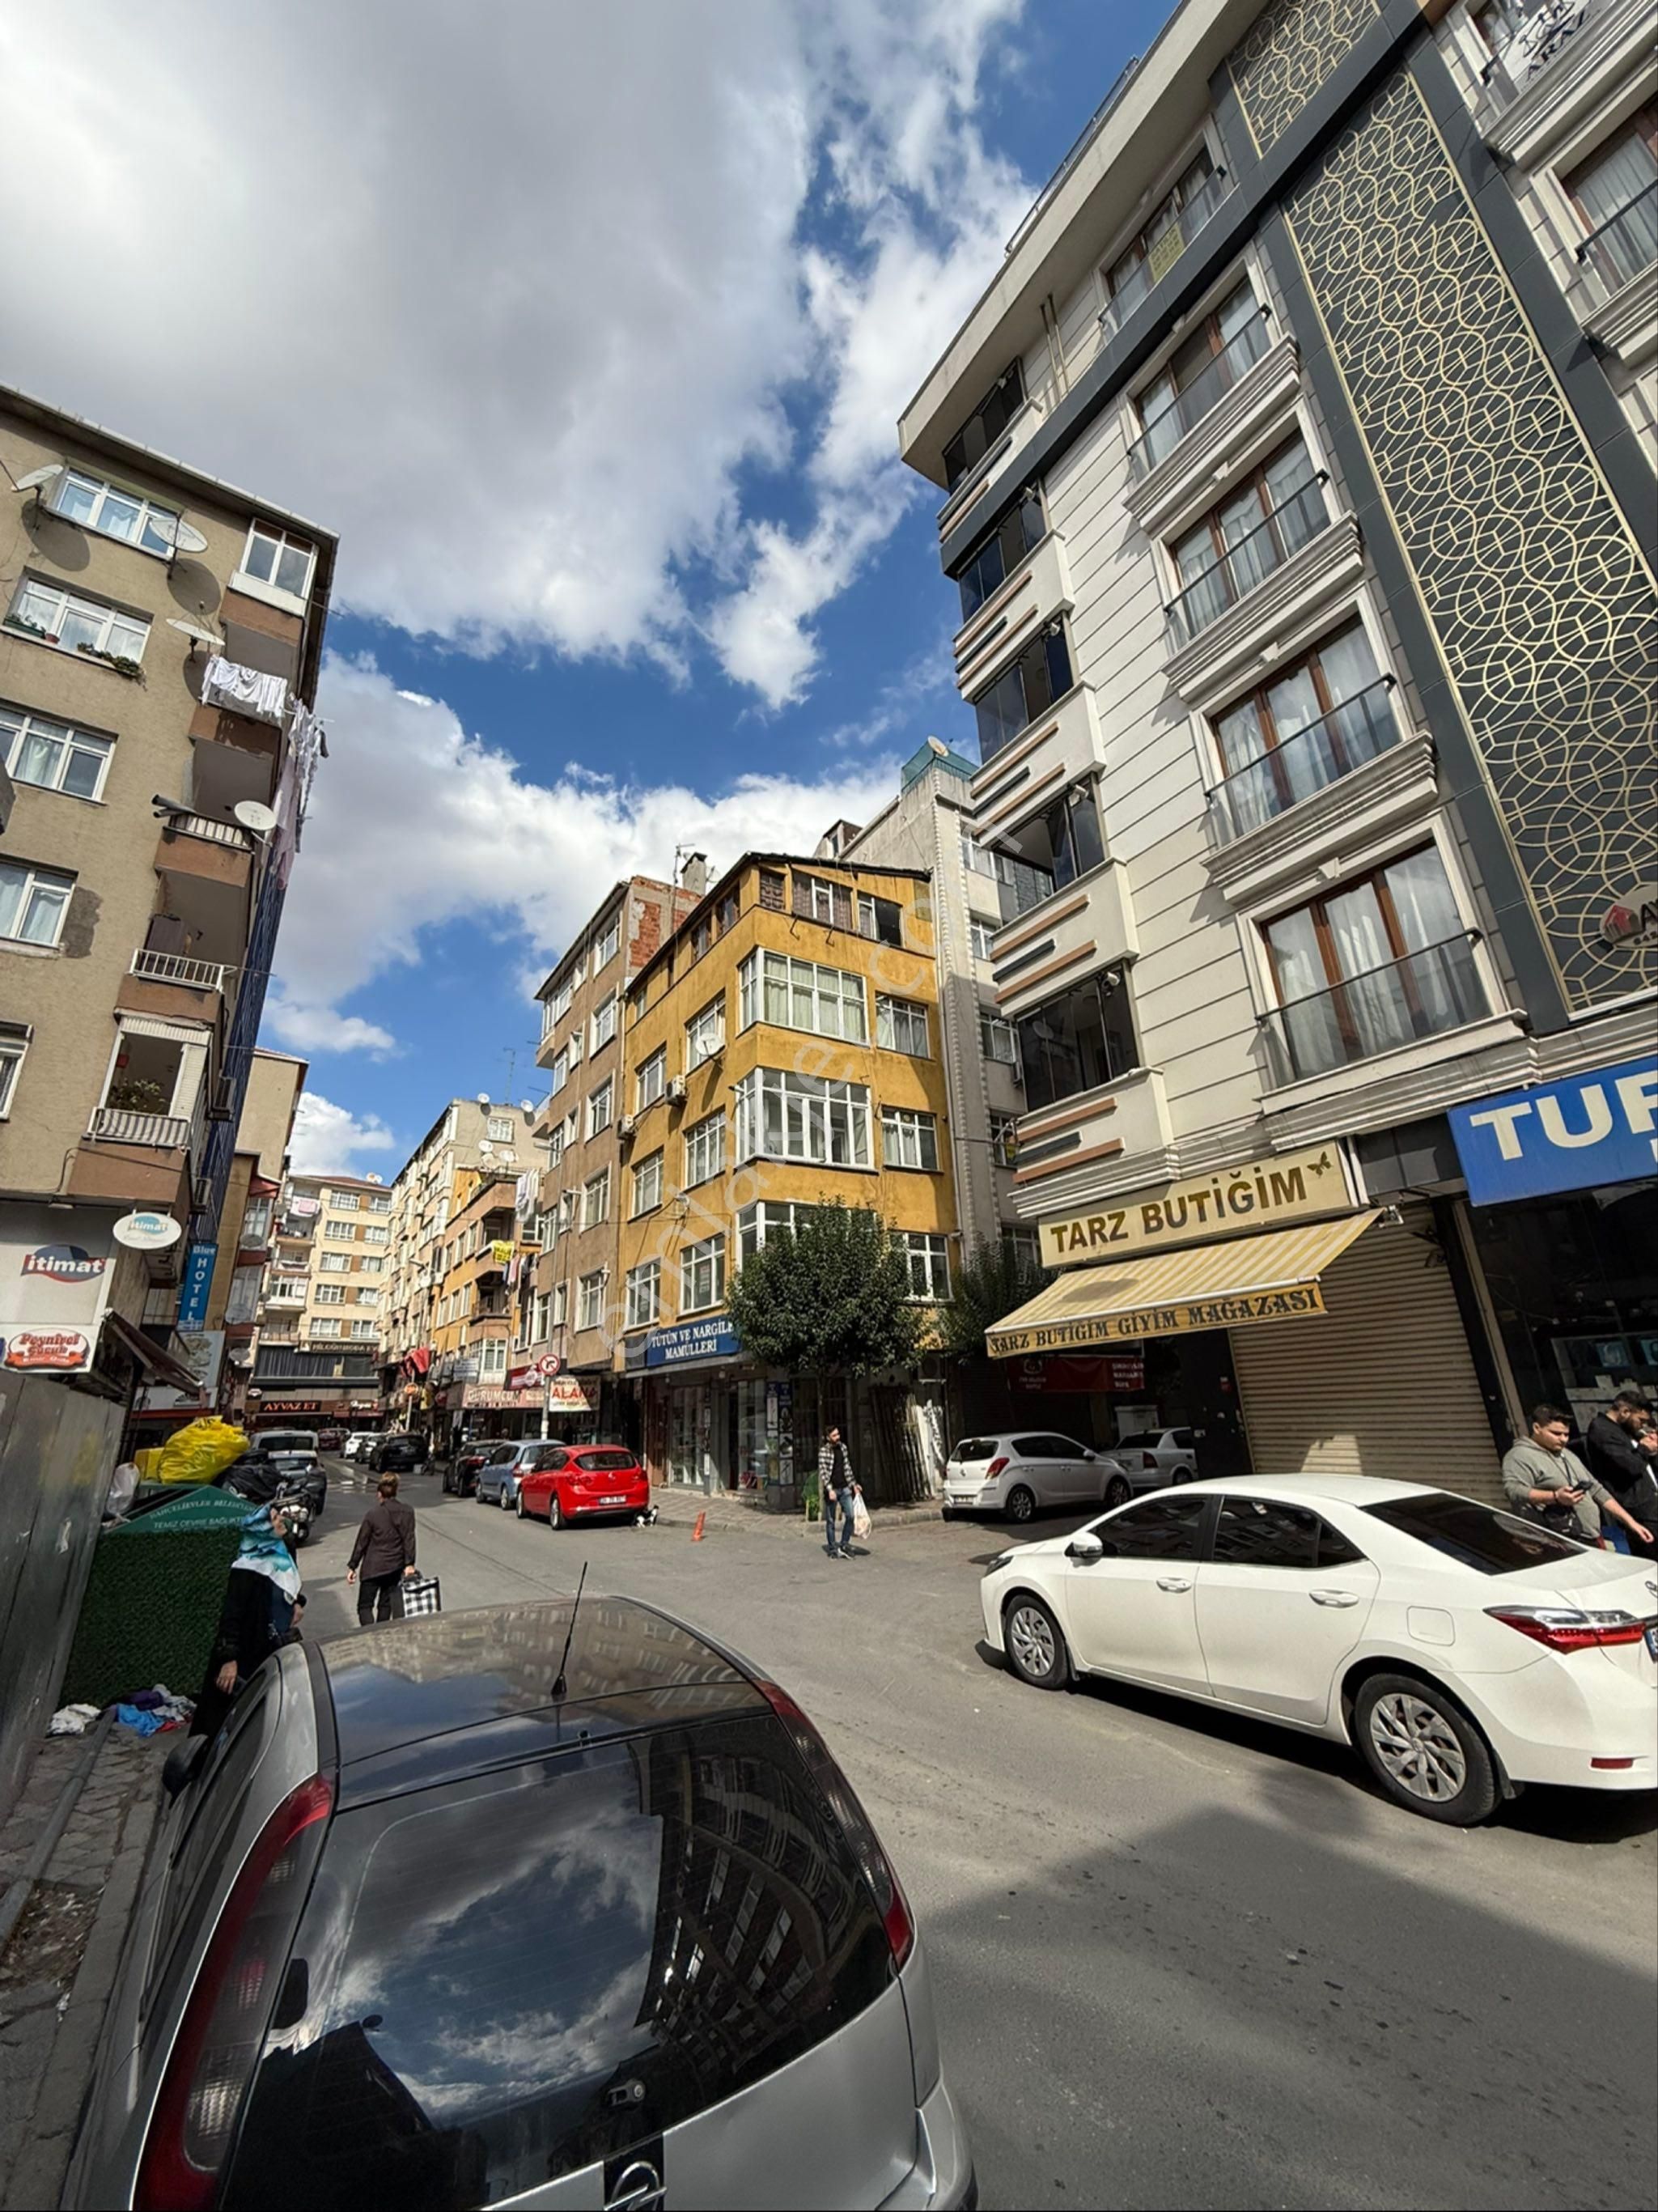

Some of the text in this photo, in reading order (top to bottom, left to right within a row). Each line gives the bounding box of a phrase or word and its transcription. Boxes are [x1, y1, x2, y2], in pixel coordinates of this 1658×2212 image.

[1050, 1166, 1308, 1254] TARZ BUTİĞİM
[193, 1245, 216, 1255] Blue
[27, 1255, 103, 1273] itimat
[187, 1257, 208, 1321] HOTEL
[989, 1333, 1029, 1354] TARZ
[1117, 1306, 1179, 1335] GİYİM
[1187, 1288, 1321, 1326] MAĞAZASI
[652, 1331, 679, 1348] TÜTÜN
[679, 1328, 692, 1343] VE
[665, 1339, 718, 1360] MAMÜLLERİ
[263, 1401, 319, 1412] AYVAZ ET
